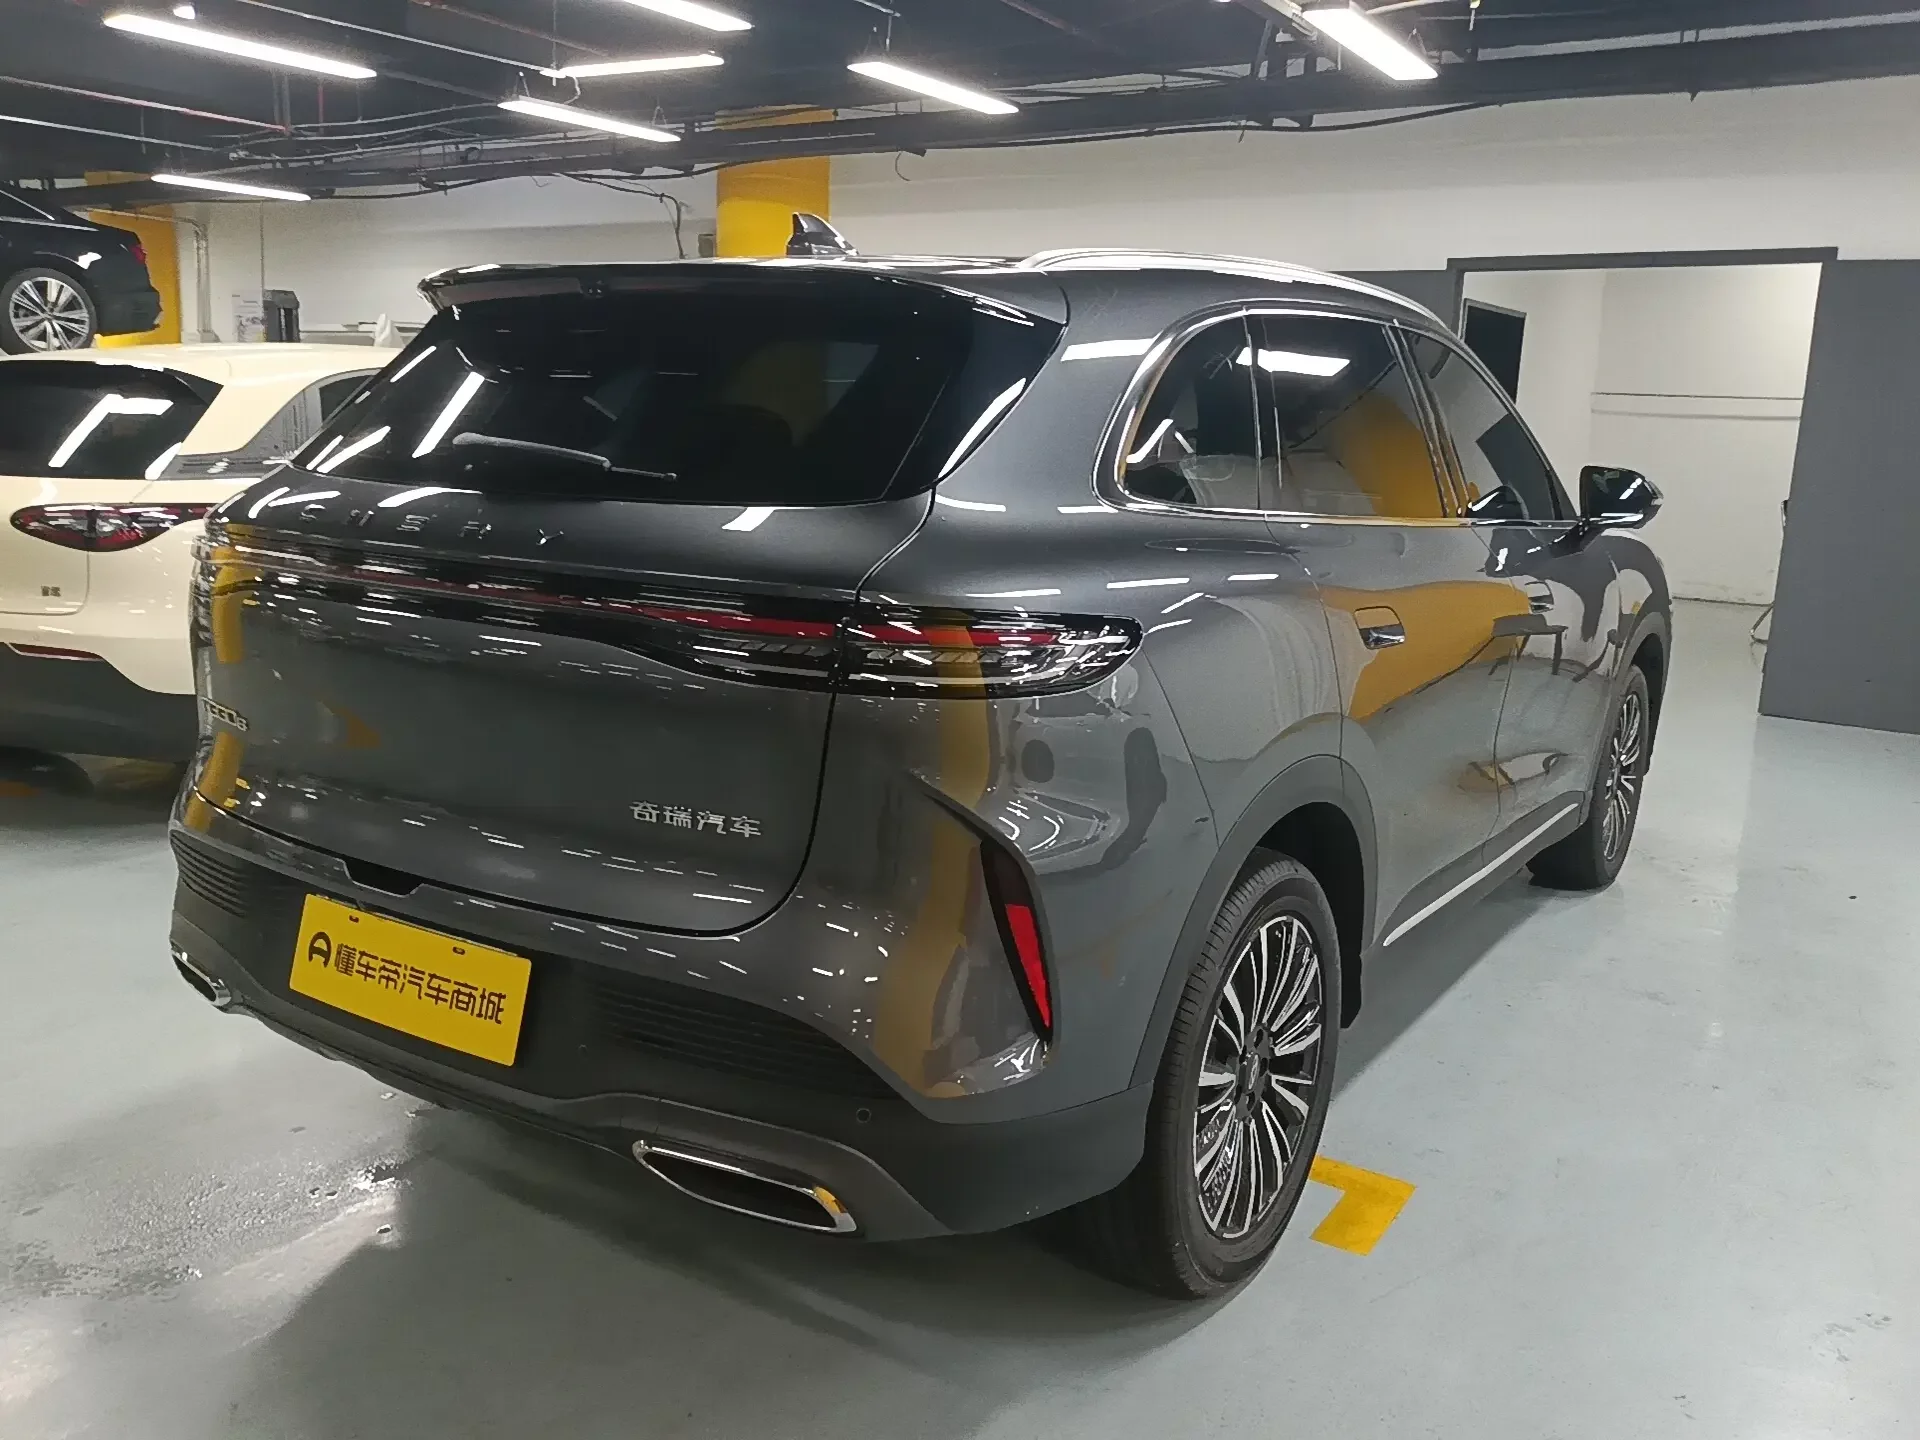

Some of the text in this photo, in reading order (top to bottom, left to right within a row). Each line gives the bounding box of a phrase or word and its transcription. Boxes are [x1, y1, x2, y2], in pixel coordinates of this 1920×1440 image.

[629, 800, 762, 838] 奇瑞汽车
[334, 943, 507, 1025] 懂车帝汽车商城
